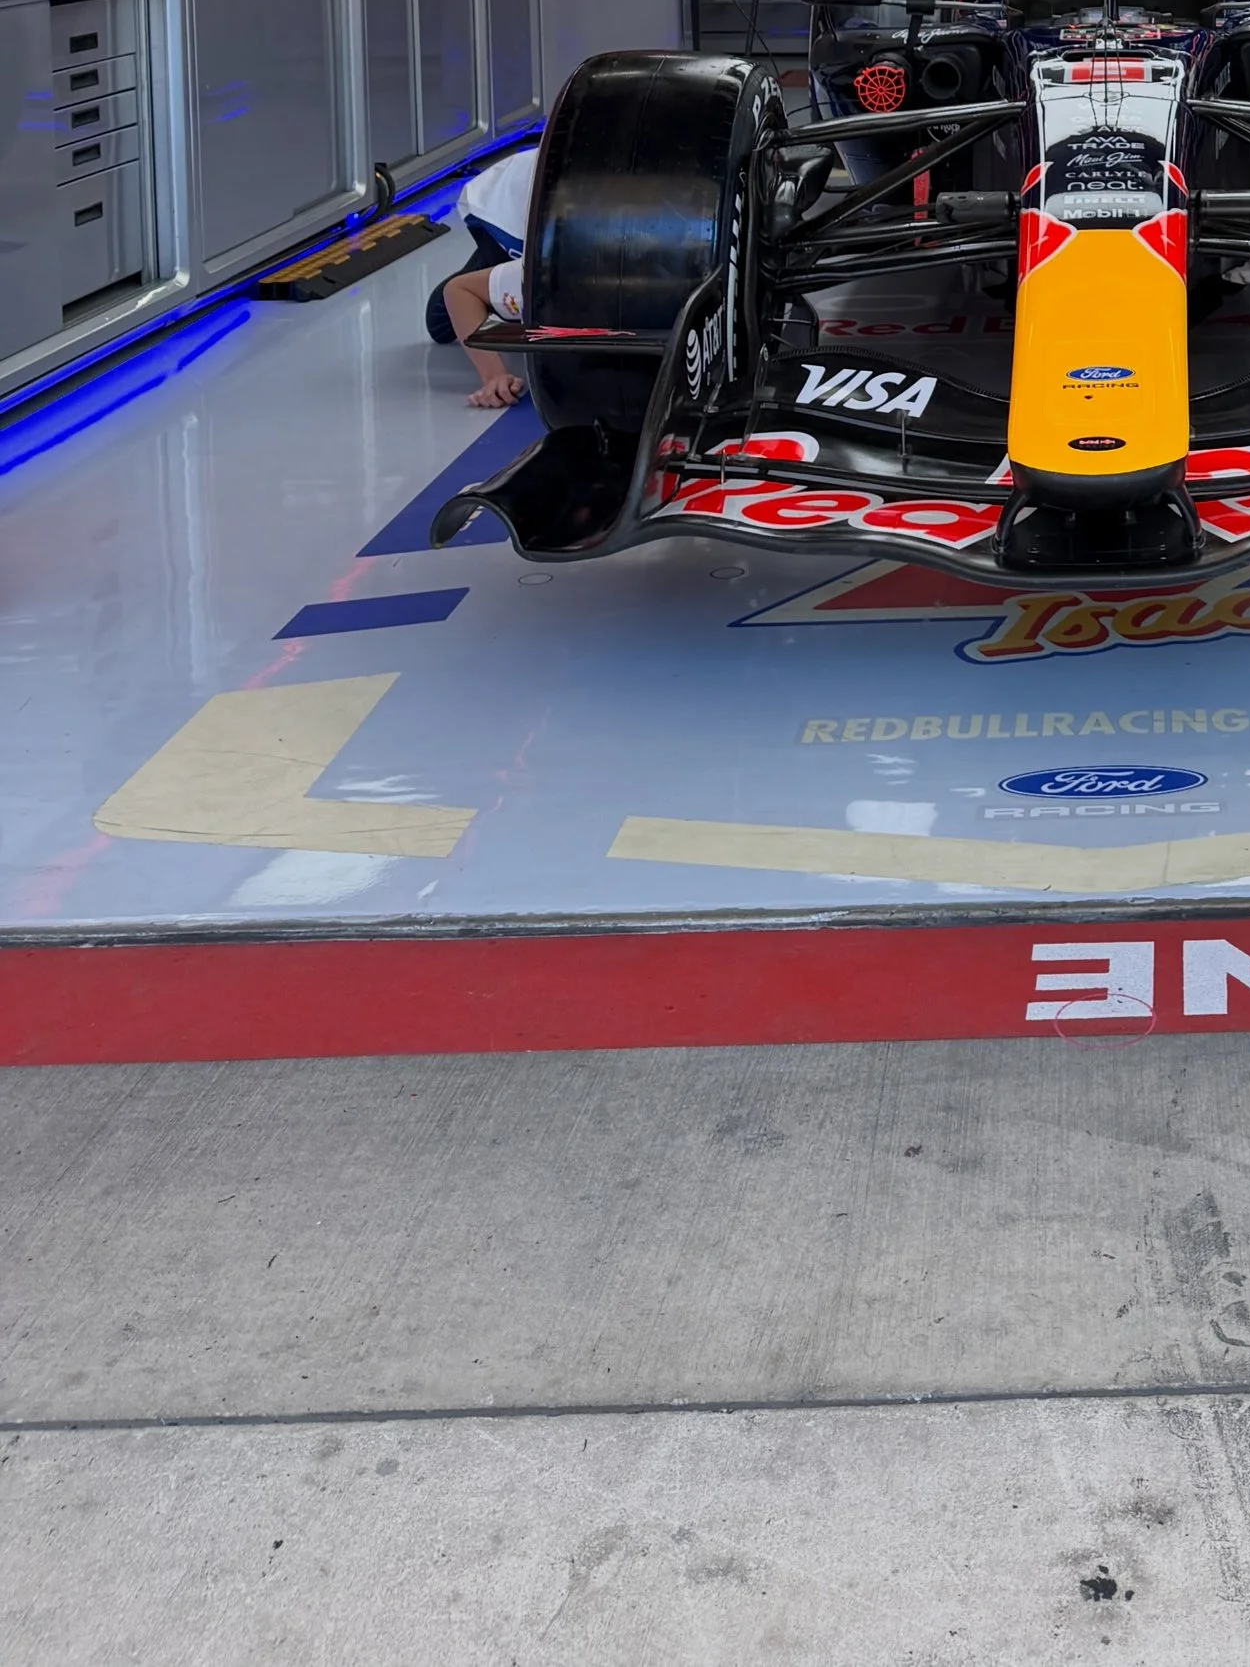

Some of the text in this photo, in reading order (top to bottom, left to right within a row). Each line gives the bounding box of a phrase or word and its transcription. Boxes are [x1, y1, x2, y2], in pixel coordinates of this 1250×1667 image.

[1067, 142, 1146, 150] TRADE
[1085, 135, 1128, 143] AVA
[1066, 152, 1104, 167] Maui
[1065, 170, 1147, 179] CARLYLE
[1063, 208, 1123, 220] Mobil
[702, 306, 724, 372] AT&T
[1080, 368, 1122, 379] Ford
[794, 363, 938, 419] VISA
[652, 431, 1010, 550] Red
[1040, 769, 1165, 797] Ford
[984, 801, 1221, 820] RACING
